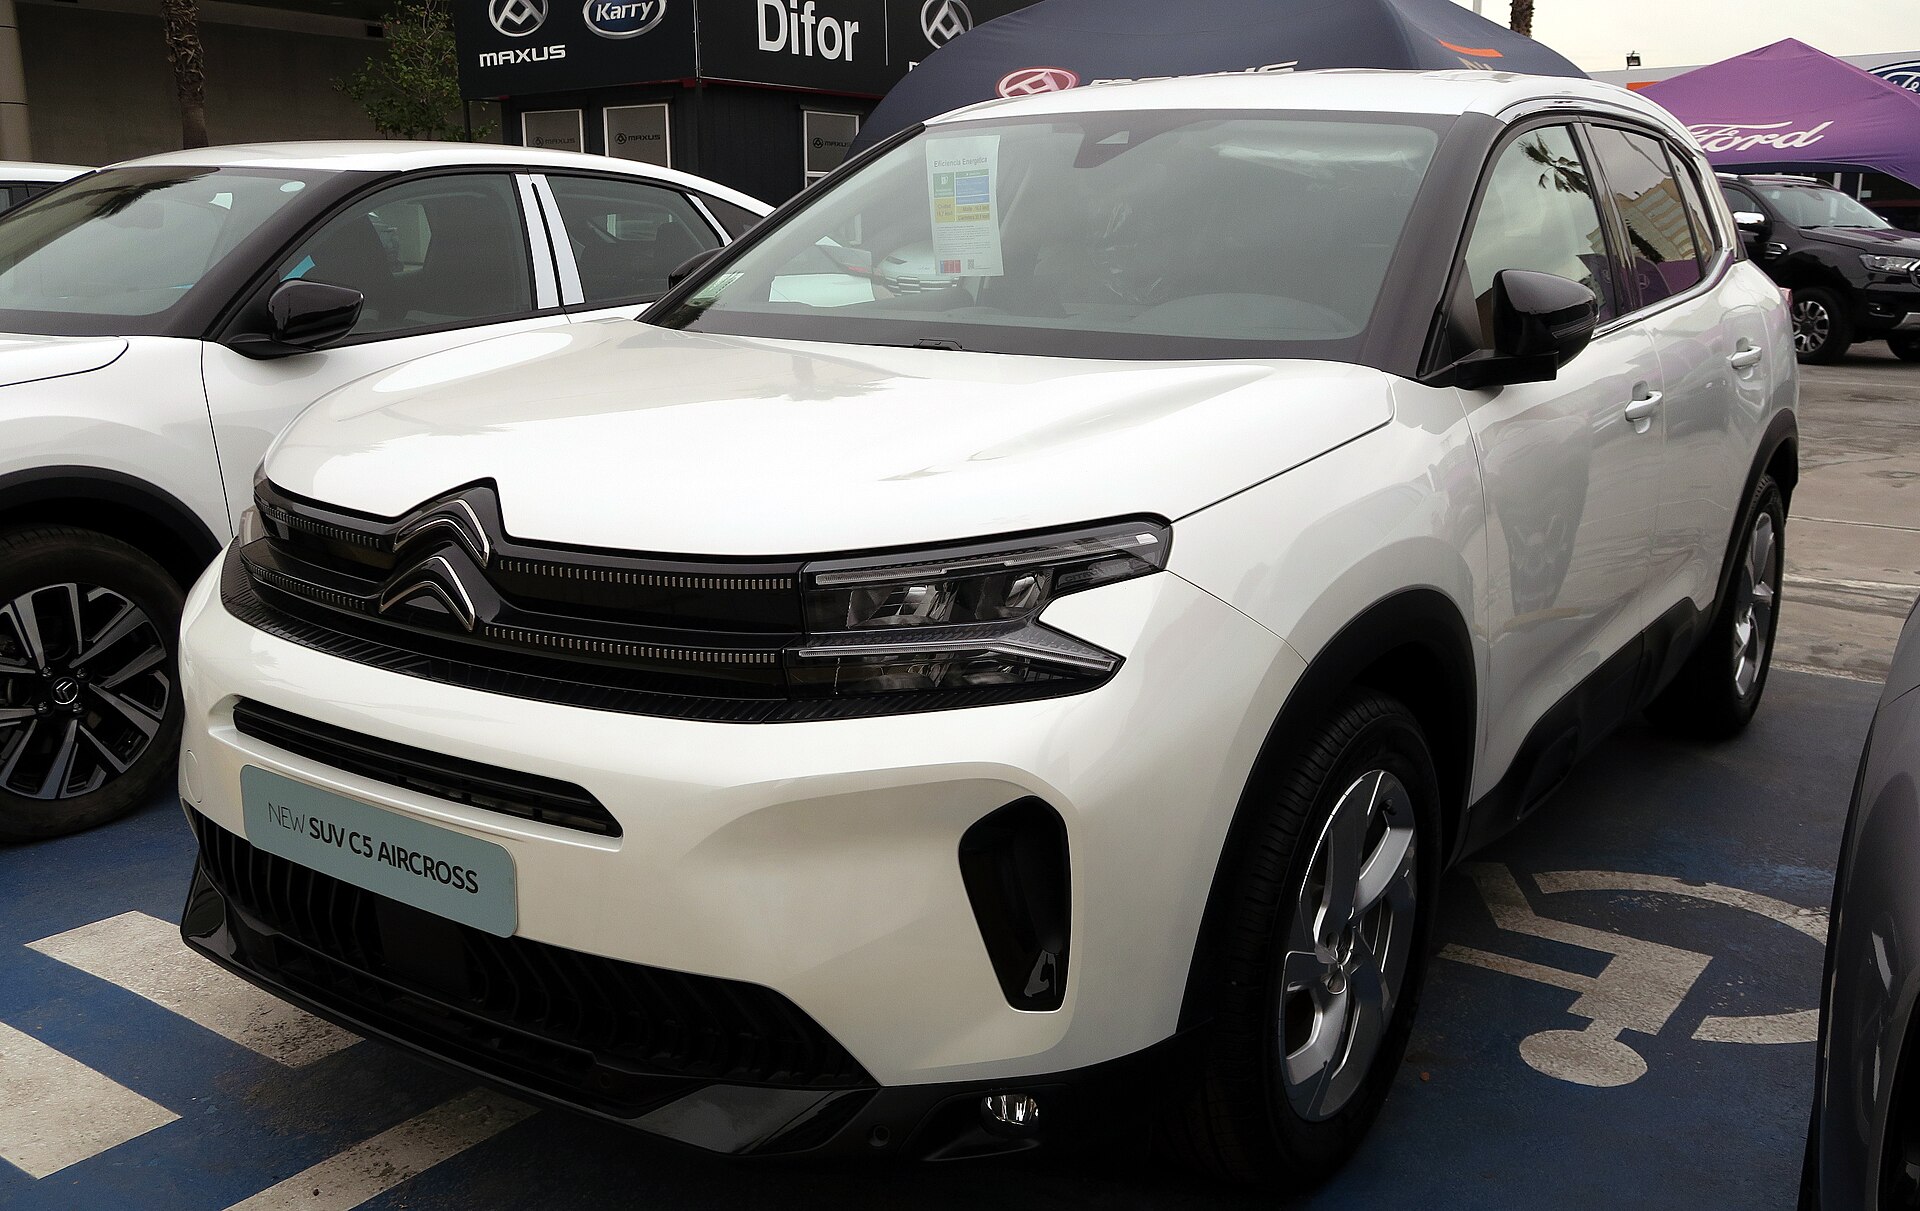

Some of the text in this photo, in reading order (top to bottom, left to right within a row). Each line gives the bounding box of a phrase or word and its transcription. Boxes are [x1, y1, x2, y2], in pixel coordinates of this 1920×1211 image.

[595, 1, 653, 22] Karry
[757, 0, 860, 61] Difor
[479, 44, 566, 67] MAXUS
[626, 134, 661, 142] MAXUS
[1686, 120, 1834, 152] Ford
[268, 802, 479, 894] NEW SUV C5 AIRCROSS
